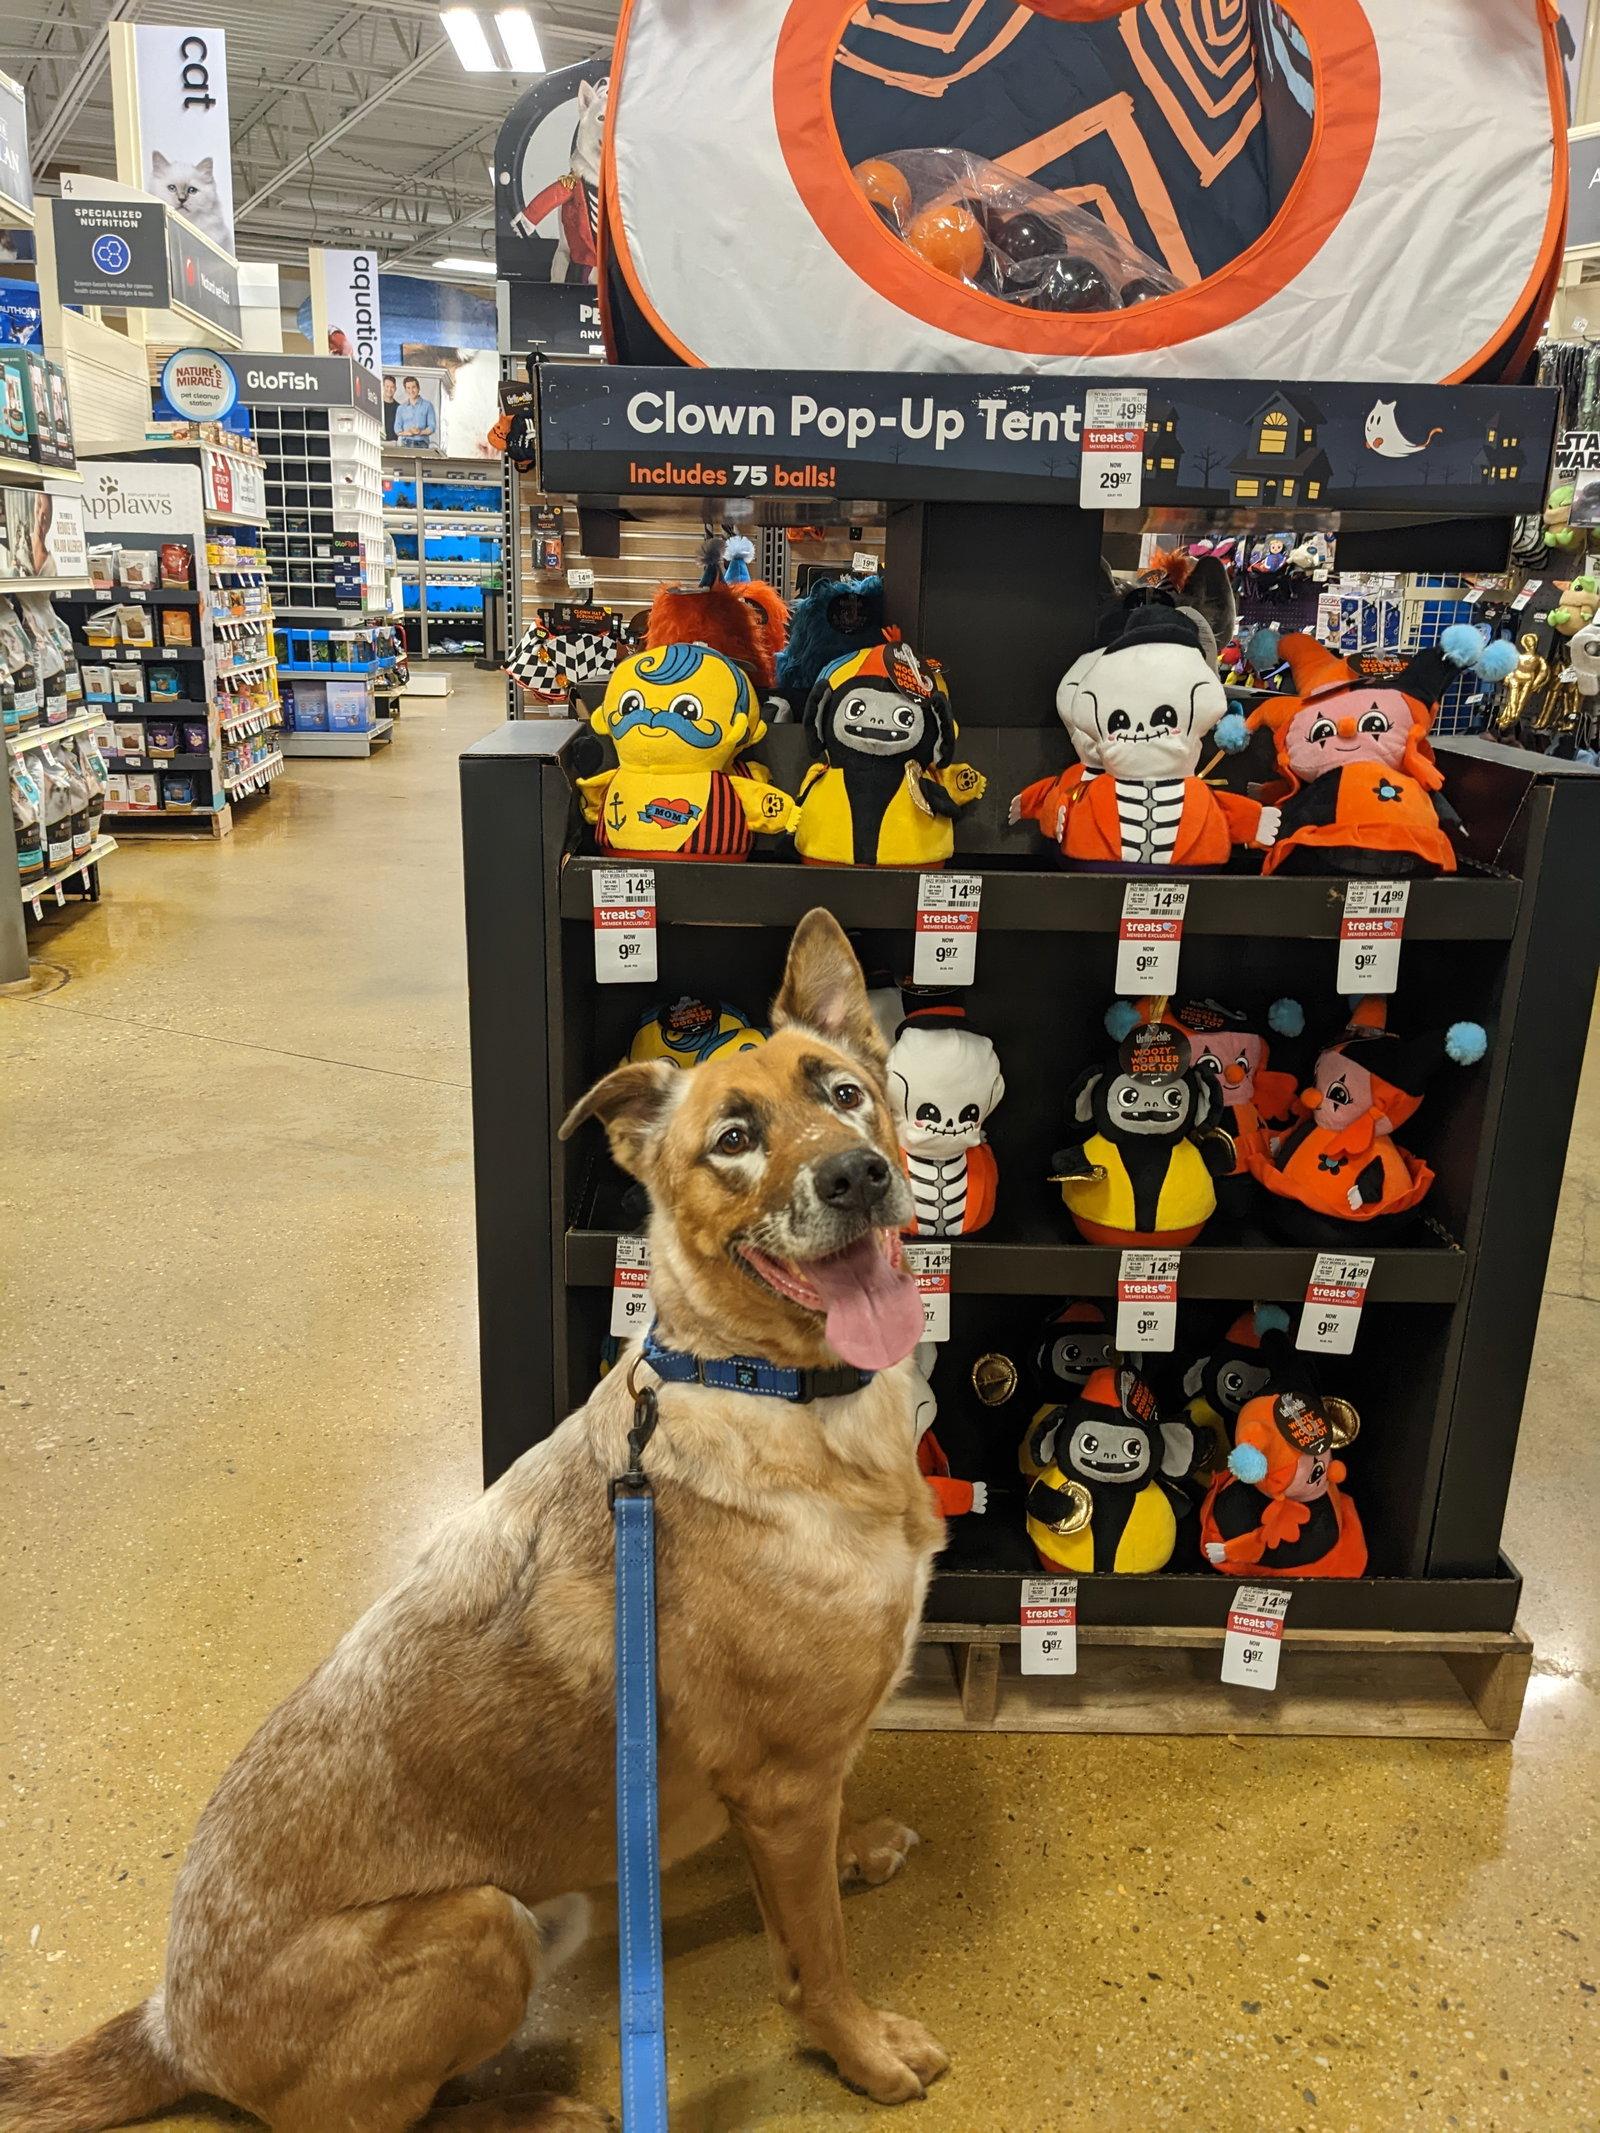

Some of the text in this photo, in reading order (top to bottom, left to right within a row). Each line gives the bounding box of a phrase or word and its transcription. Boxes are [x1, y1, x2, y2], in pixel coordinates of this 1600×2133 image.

[181, 36, 216, 109] cat
[64, 179, 73, 193] 4
[75, 208, 142, 219] SPECIALIZED
[80, 218, 138, 228] NUTRITION
[349, 256, 377, 369] aquatics
[580, 304, 601, 325] PE
[176, 364, 222, 379] NATURE'S
[177, 377, 223, 389] MIRACLE
[247, 371, 318, 390] GloFish
[193, 392, 220, 400] cleanup
[627, 390, 1082, 449] Clown Pop-Up Tent
[1089, 432, 1125, 443] treats
[1556, 433, 1600, 451] STA
[1555, 451, 1600, 469] WAR
[629, 462, 836, 488] Includes 75 balls!
[80, 492, 172, 520] Applaws
[655, 808, 682, 821] MOM
[600, 910, 636, 920] treats
[923, 914, 958, 923] treats
[1126, 922, 1162, 932] treats
[1347, 921, 1382, 930] treats
[1131, 1055, 1179, 1063] WOBBLER
[1133, 1064, 1156, 1072] DOG
[620, 1271, 648, 1280] treat
[915, 1277, 931, 1286] ats
[1124, 1284, 1158, 1293] treats
[1313, 1286, 1346, 1298] treats
[1291, 1418, 1324, 1438] WOBER
[1026, 1609, 1058, 1618] treats
[1233, 1614, 1266, 1628] treats
